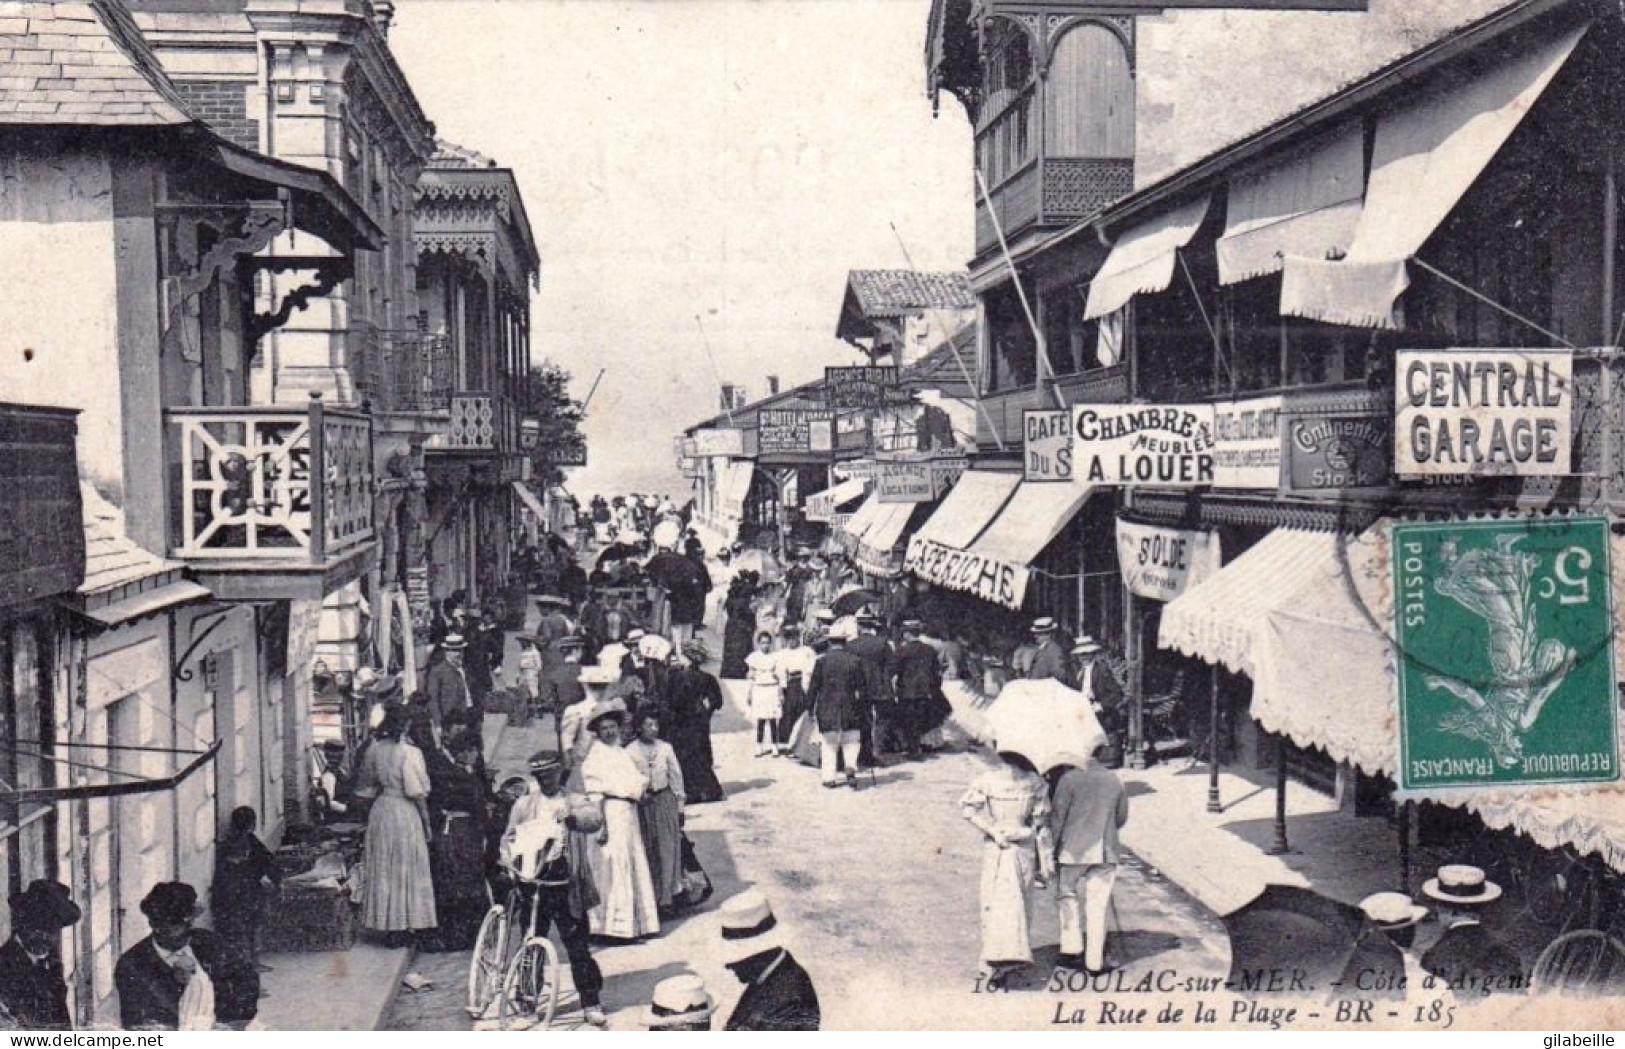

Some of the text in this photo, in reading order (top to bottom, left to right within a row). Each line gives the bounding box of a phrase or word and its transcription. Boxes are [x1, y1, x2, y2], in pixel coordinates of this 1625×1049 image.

[1406, 360, 1562, 407] CENTRAL
[1294, 419, 1387, 454] Continental
[1411, 414, 1557, 463] GARAGE
[882, 462, 926, 478] AGENCE
[1030, 451, 1050, 474] DU
[1119, 454, 1214, 481] LOUER
[881, 484, 929, 496] LOCATIONS
[1312, 469, 1369, 486] Stock
[1139, 534, 1186, 570] SOLDE
[1404, 542, 1425, 627] POSTES
[1522, 753, 1610, 774] REPUBLIQUE
